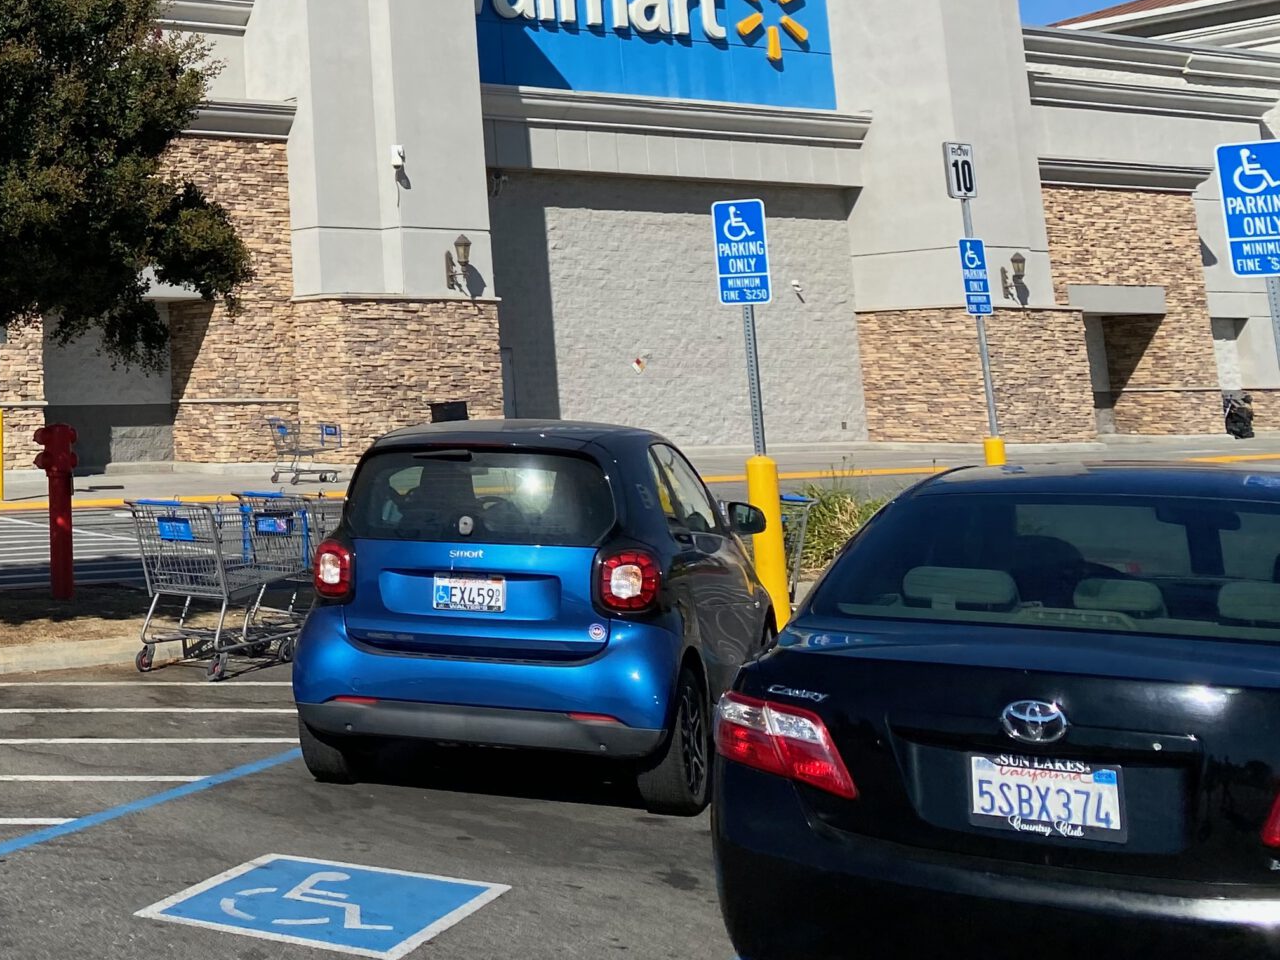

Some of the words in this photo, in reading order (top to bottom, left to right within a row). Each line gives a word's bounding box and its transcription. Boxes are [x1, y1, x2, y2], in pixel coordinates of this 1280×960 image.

[951, 147, 969, 157] ROW
[952, 159, 974, 193] 10
[1226, 193, 1280, 215] PARKIN
[1243, 215, 1280, 236] ONLY
[718, 241, 765, 257] PARKING
[728, 258, 757, 273] ONLY
[1236, 258, 1262, 272] FINE
[727, 277, 761, 288] MINIMUM
[722, 290, 740, 301] FINE
[745, 289, 768, 300] $250
[449, 549, 484, 559] smart
[450, 586, 495, 607] EX459
[1000, 754, 1030, 768] SUN
[1033, 756, 1085, 772] LAKES
[978, 779, 1113, 828] 5SBX374
[1008, 814, 1053, 837] Country
[1053, 820, 1085, 838] Club
